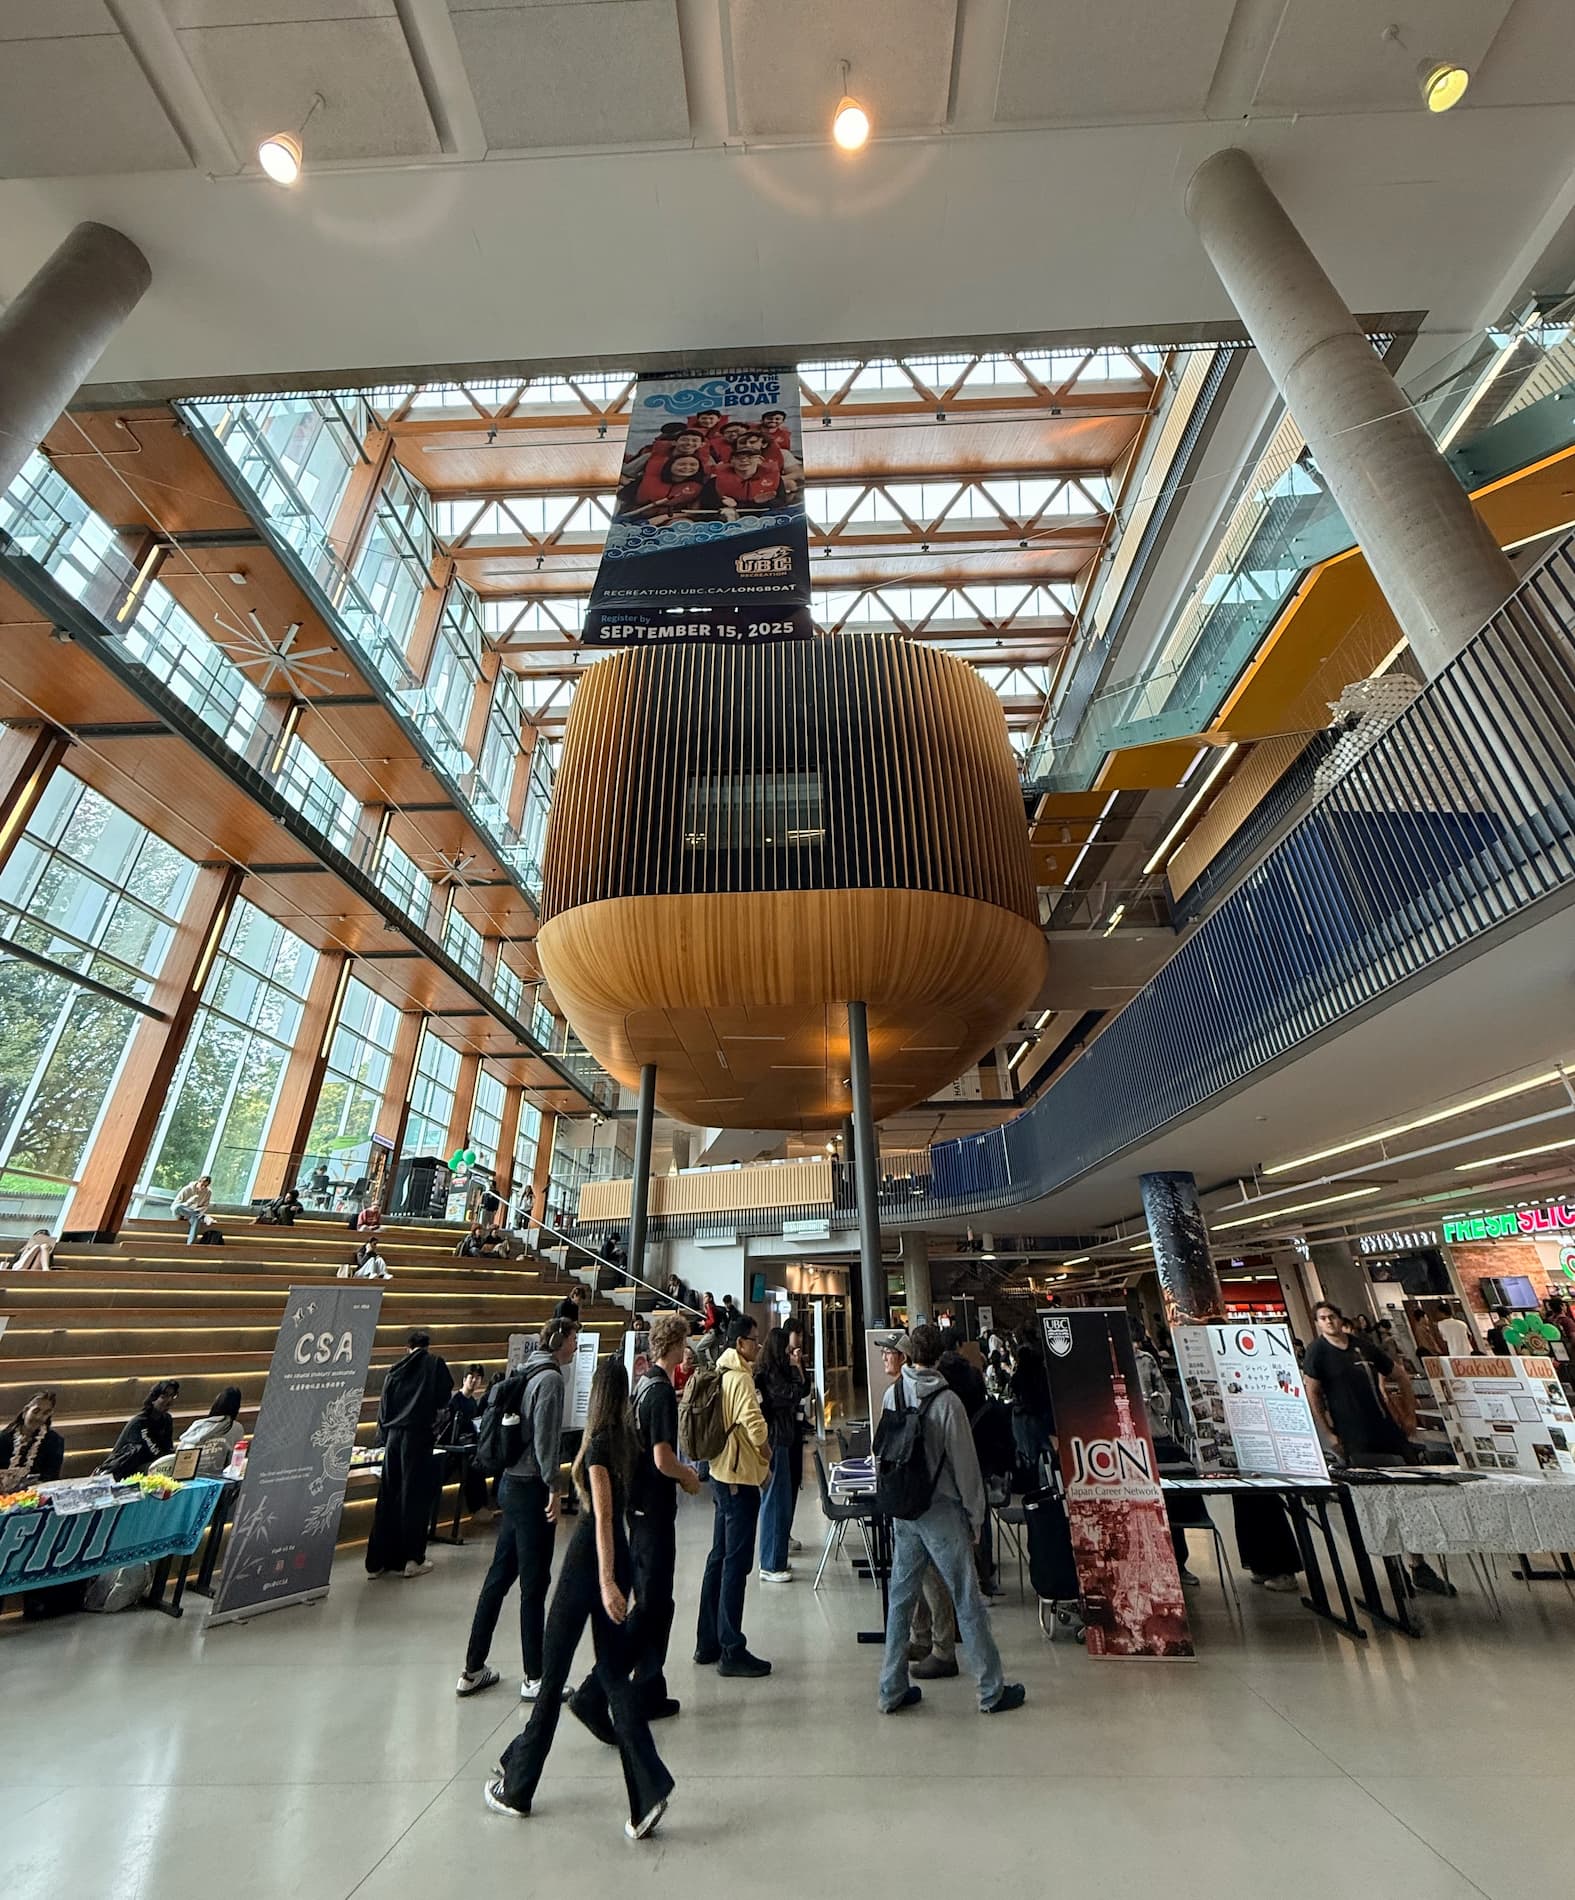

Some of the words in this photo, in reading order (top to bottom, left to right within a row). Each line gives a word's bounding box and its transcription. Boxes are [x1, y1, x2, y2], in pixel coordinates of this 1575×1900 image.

[725, 381, 780, 394] LONG
[725, 392, 780, 406] BOAT
[735, 556, 792, 573] UBC
[601, 614, 637, 623] Register
[640, 615, 651, 625] by
[600, 624, 711, 640] SEPTEMBER
[717, 625, 742, 640] 15,
[748, 622, 794, 638] 2025
[1046, 1319, 1068, 1329] UBC
[294, 1331, 353, 1365] CSA
[1216, 1327, 1293, 1357] JCN
[1452, 1358, 1509, 1377] Baking
[1073, 1440, 1151, 1483] JCN
[1071, 1486, 1094, 1498] Japan
[1095, 1486, 1121, 1496] Career
[1123, 1486, 1160, 1496] Network
[0, 1503, 122, 1576] FIJI
